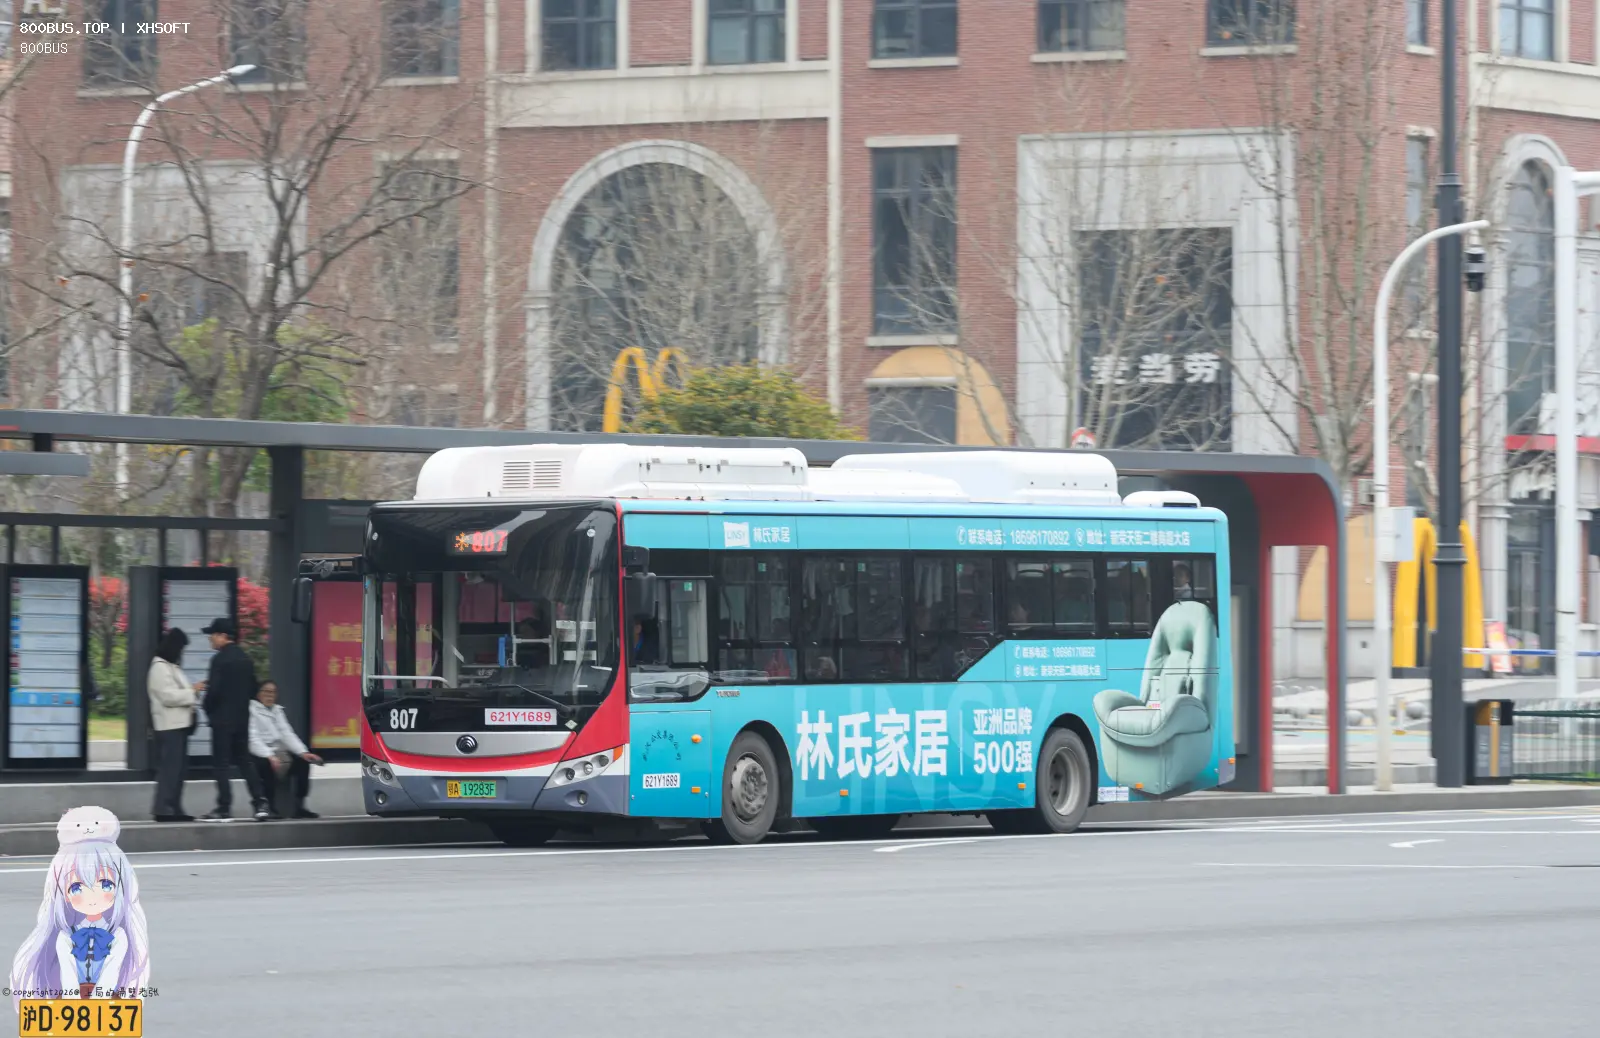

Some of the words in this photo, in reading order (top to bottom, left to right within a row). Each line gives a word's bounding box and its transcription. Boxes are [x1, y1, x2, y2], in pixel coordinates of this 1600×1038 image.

[471, 530, 509, 553] 807
[753, 526, 791, 543] 林氏家居
[390, 708, 418, 729] 807
[490, 711, 552, 723] 621Y1689
[973, 706, 1032, 736] 亚洲品牌
[796, 707, 948, 780] 林氏家居
[973, 740, 1032, 773] 500强
[645, 774, 678, 788] 621Y1689
